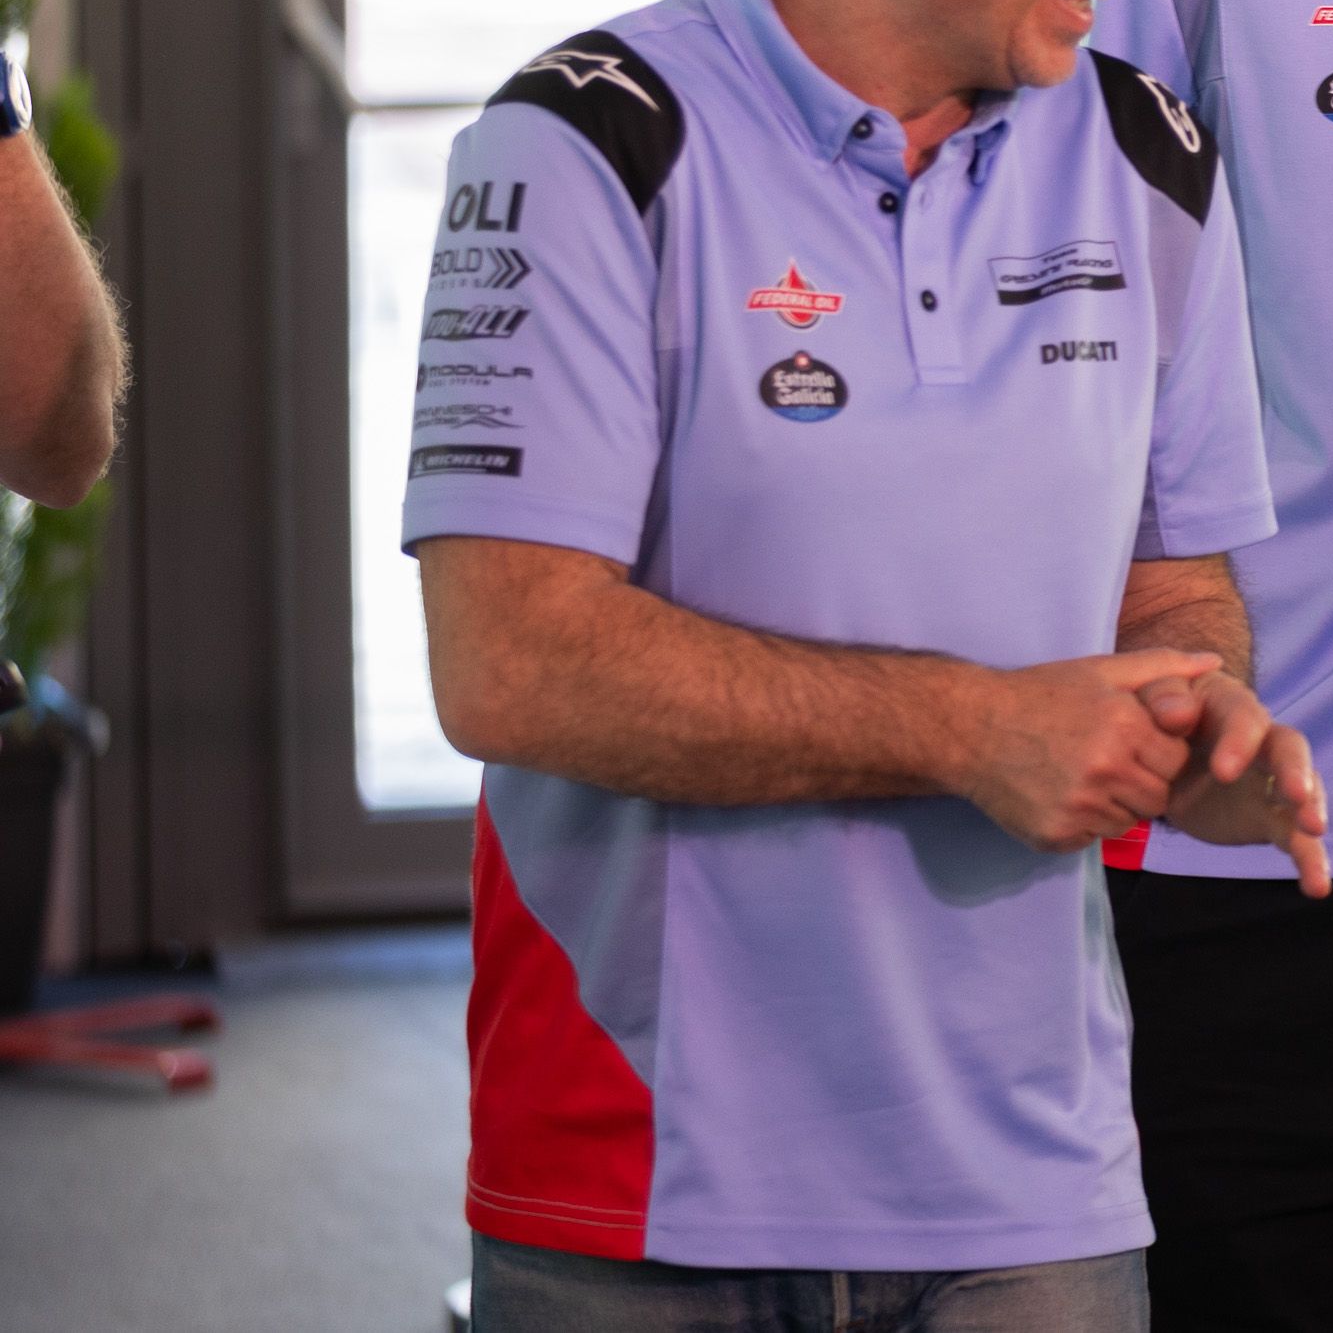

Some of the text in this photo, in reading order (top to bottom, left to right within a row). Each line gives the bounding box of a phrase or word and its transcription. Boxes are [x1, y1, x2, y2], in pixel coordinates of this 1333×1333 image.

[448, 180, 528, 233] OLI
[752, 290, 814, 307] FEDERAL
[1041, 341, 1117, 364] DUCATI
[773, 370, 836, 388] Estrella
[776, 388, 836, 405] Galicia
[425, 452, 511, 469] MICHELIN
